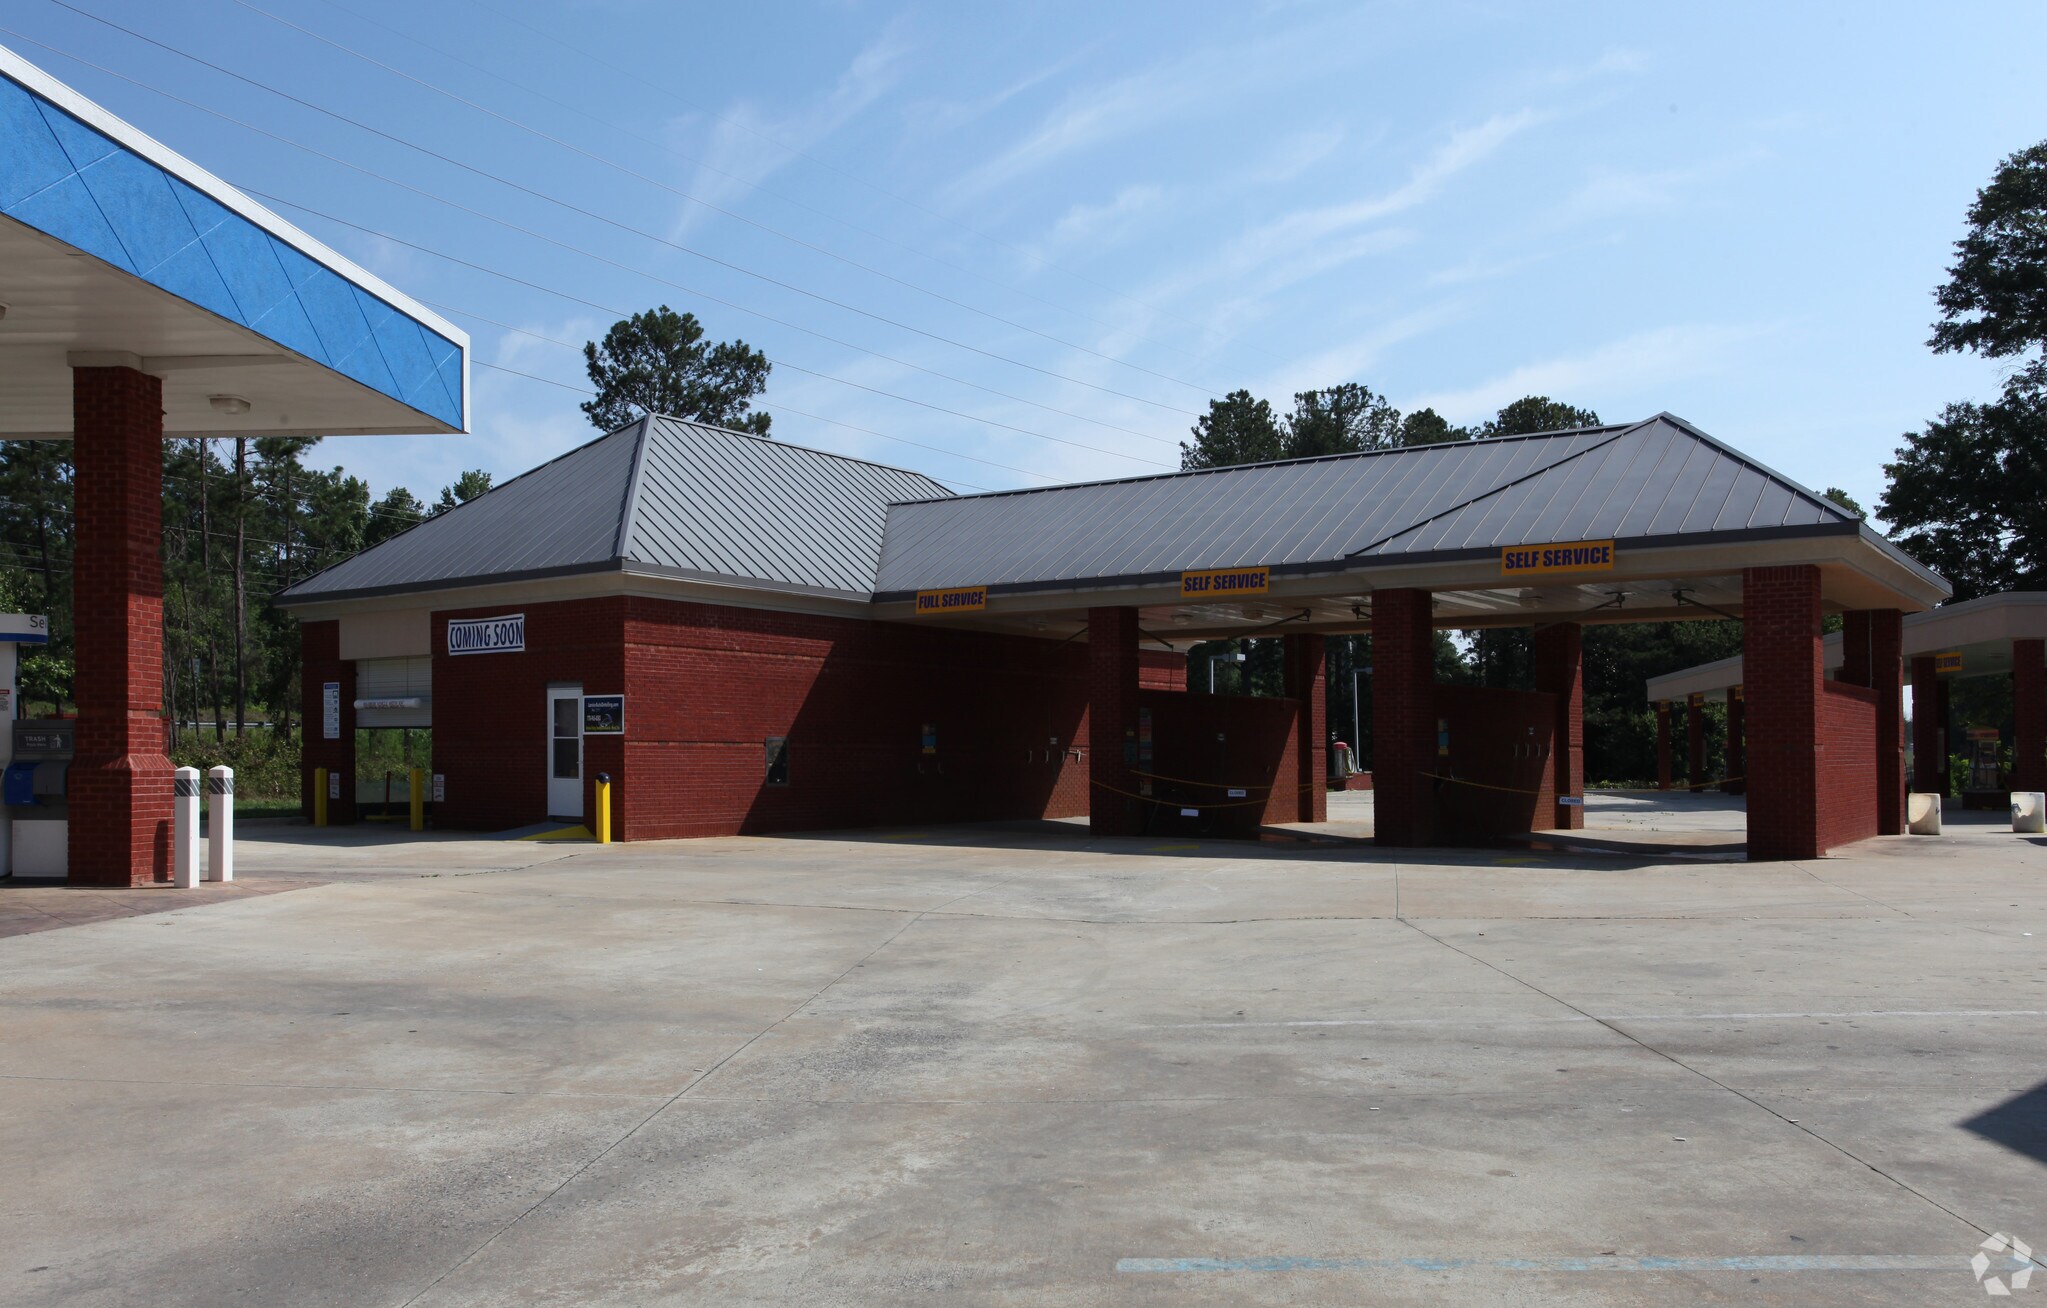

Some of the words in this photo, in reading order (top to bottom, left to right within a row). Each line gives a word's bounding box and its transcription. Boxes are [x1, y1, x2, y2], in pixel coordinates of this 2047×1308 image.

[1505, 551, 1540, 569] SELF
[1542, 546, 1610, 567] SERVICE
[1184, 575, 1211, 592] SELF
[1213, 573, 1266, 590] SERVICE
[919, 594, 940, 609] FULL
[942, 592, 984, 608] SERVICE
[450, 624, 491, 649] COMING
[493, 621, 523, 647] SOON
[24, 735, 46, 743] TRASH
